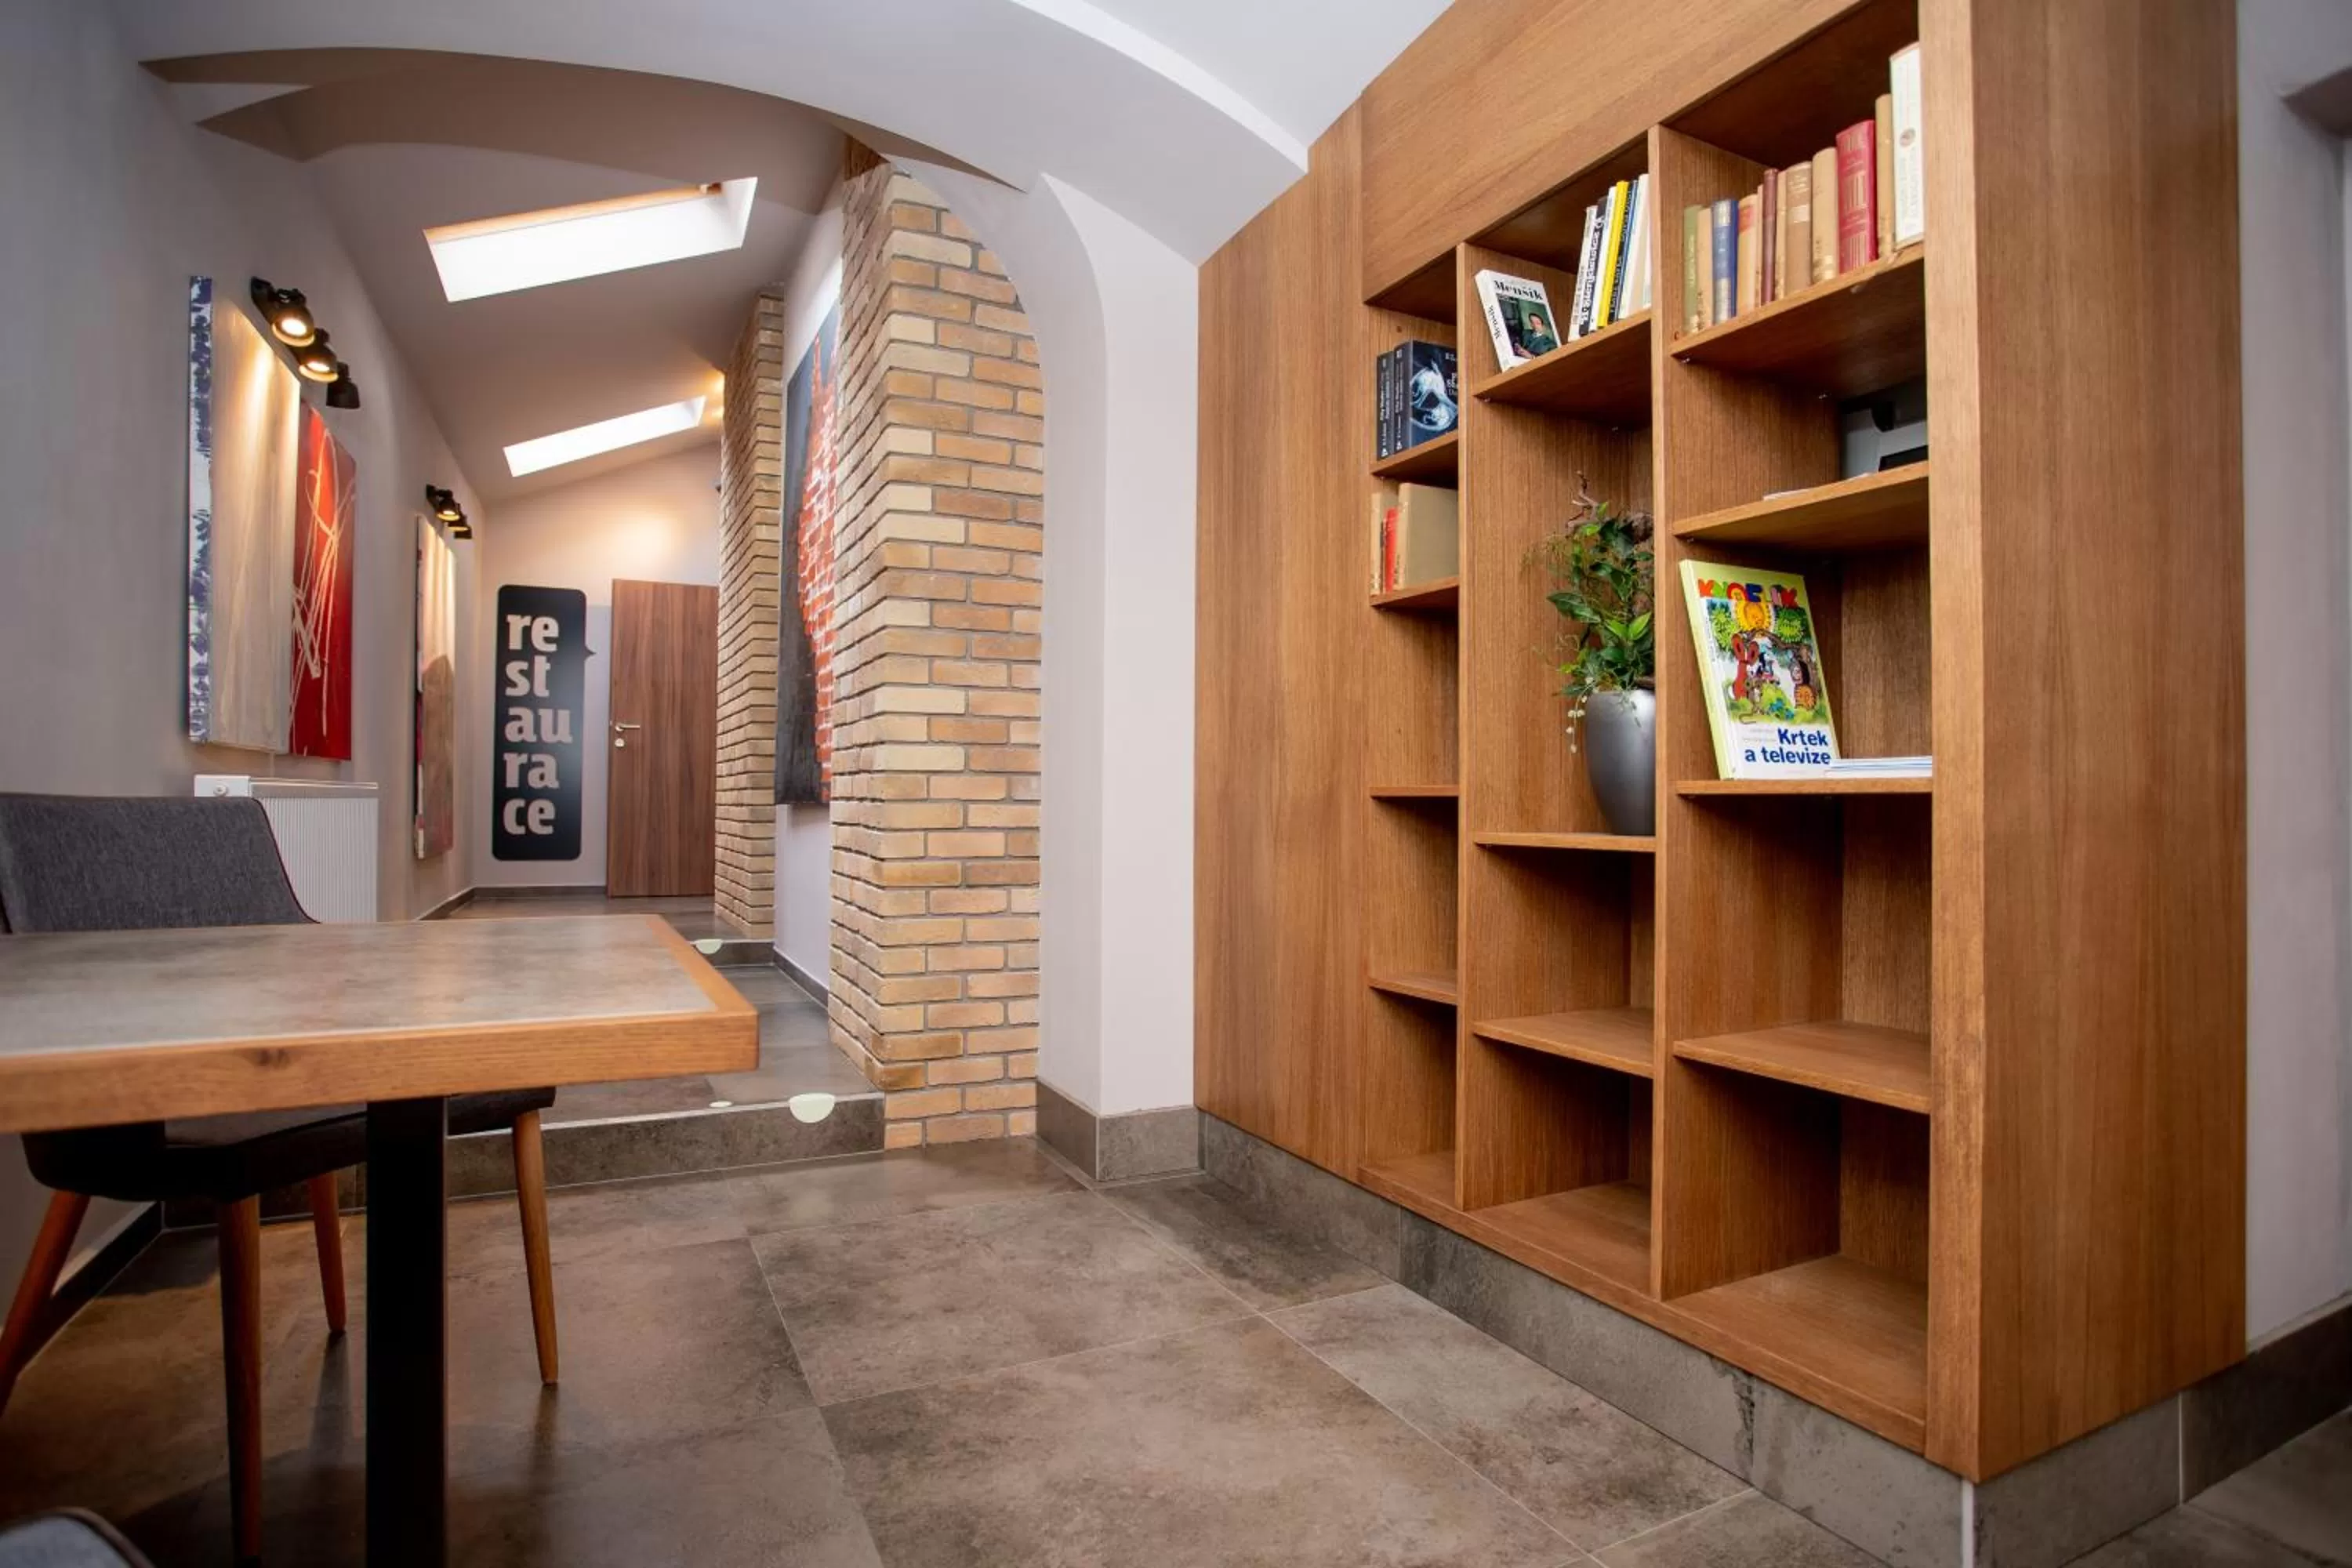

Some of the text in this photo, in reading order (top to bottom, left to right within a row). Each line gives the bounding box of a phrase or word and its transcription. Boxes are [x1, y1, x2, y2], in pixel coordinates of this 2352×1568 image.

[506, 613, 559, 653] re
[504, 655, 552, 698] st
[503, 706, 573, 744] au
[1777, 727, 1829, 746] Krtek
[503, 751, 560, 789] ra
[1744, 746, 1831, 764] a televize
[503, 797, 556, 835] ce
